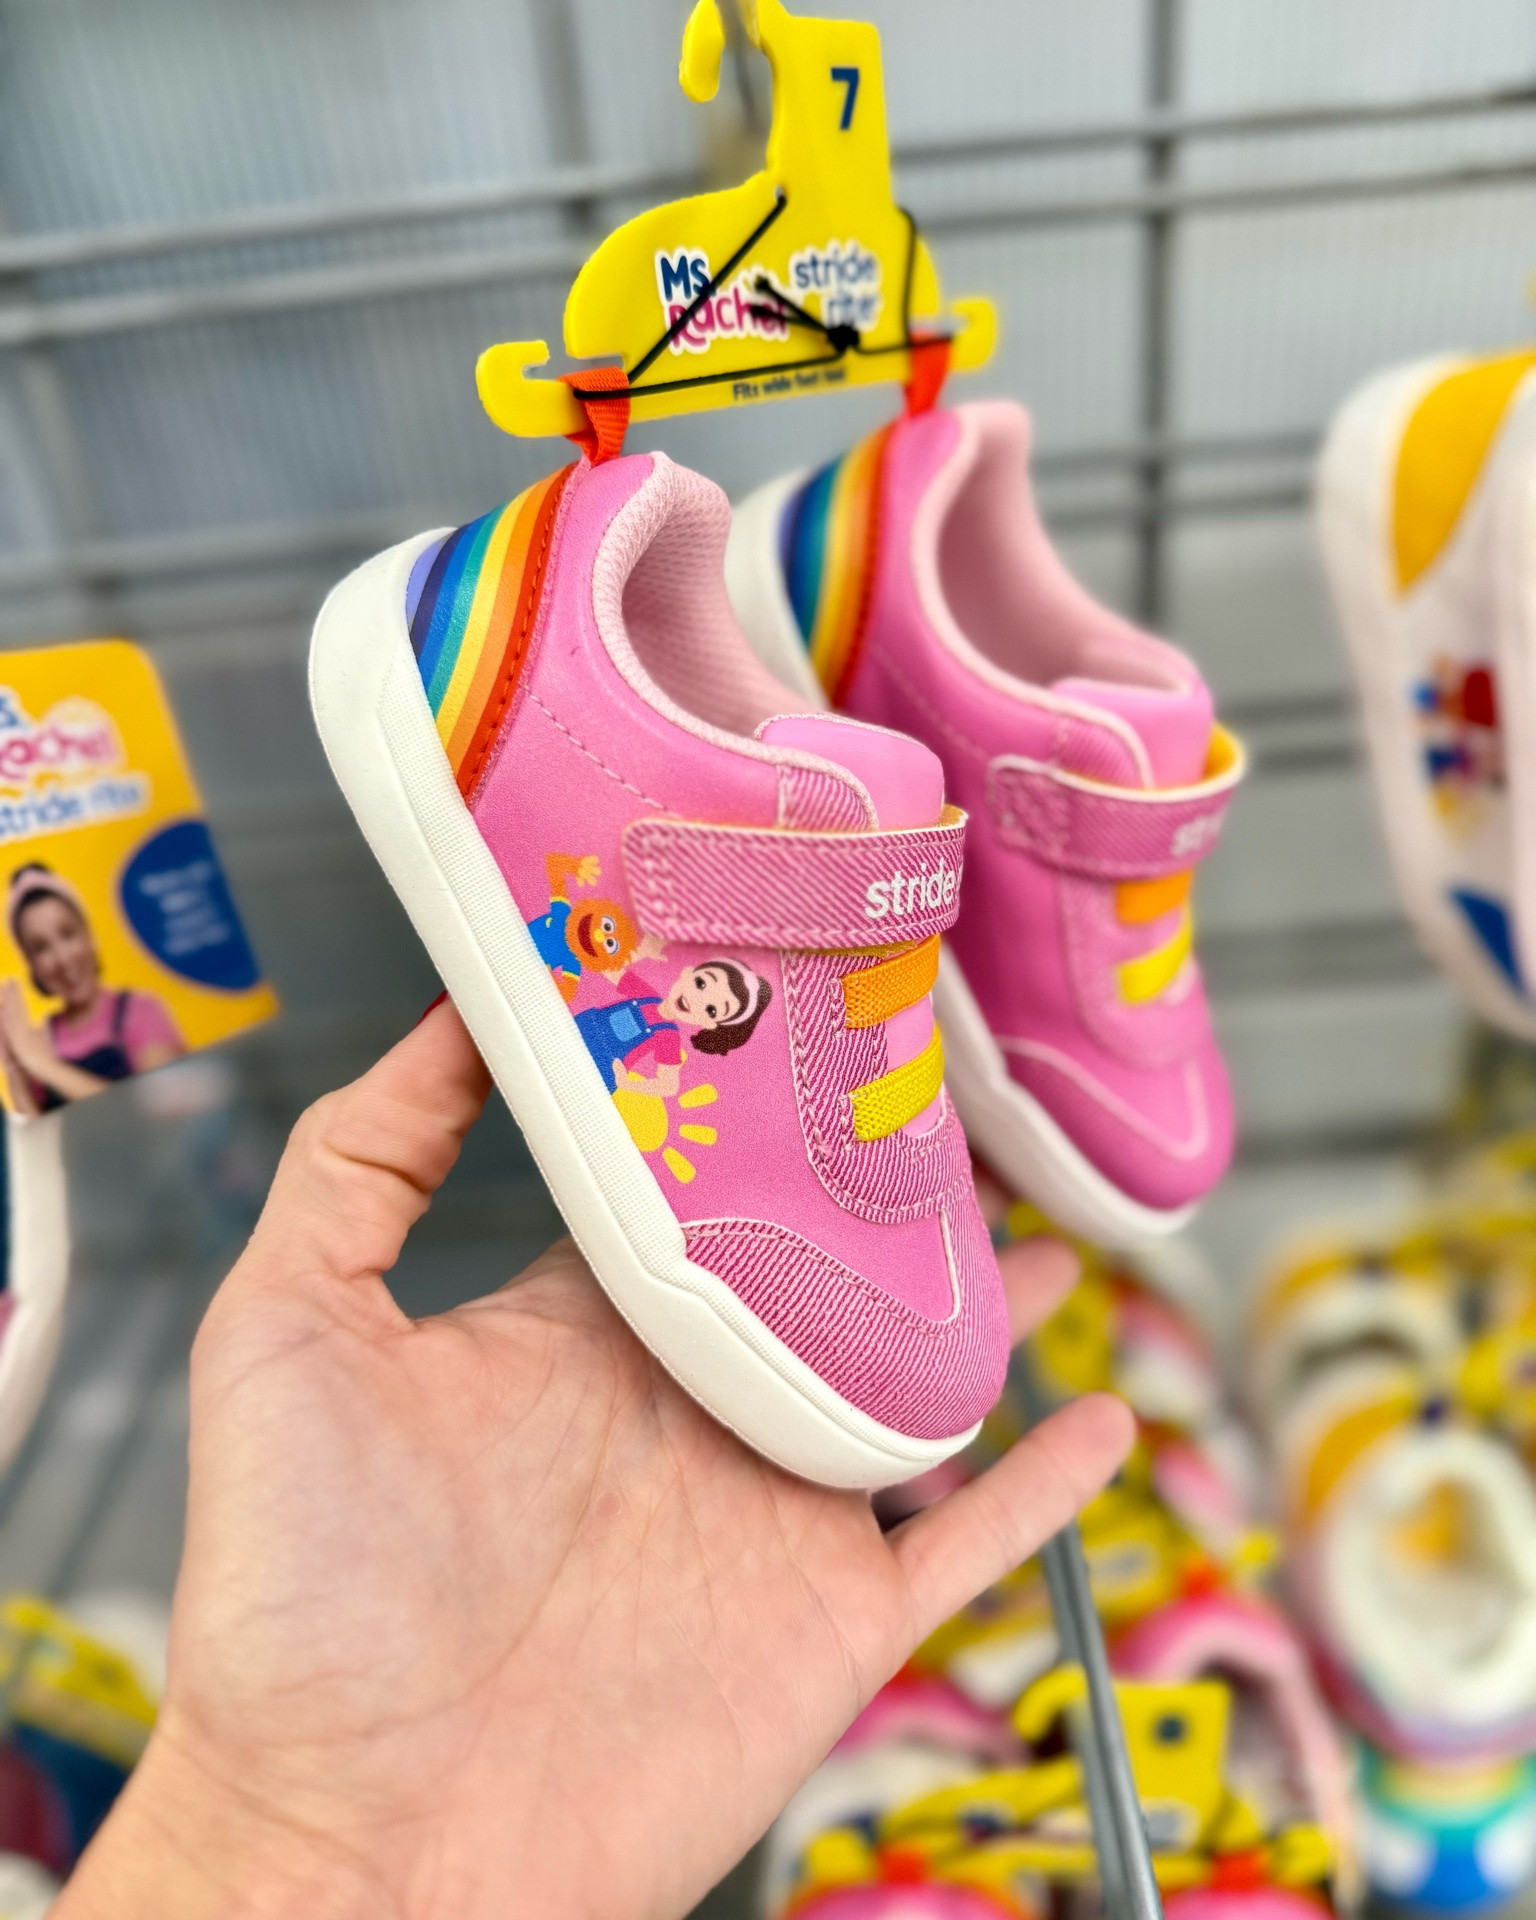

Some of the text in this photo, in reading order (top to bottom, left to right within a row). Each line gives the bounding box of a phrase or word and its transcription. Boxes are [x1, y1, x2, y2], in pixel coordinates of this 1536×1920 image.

[830, 67, 860, 131] 7
[795, 243, 876, 289] stride
[864, 857, 956, 919] stride
